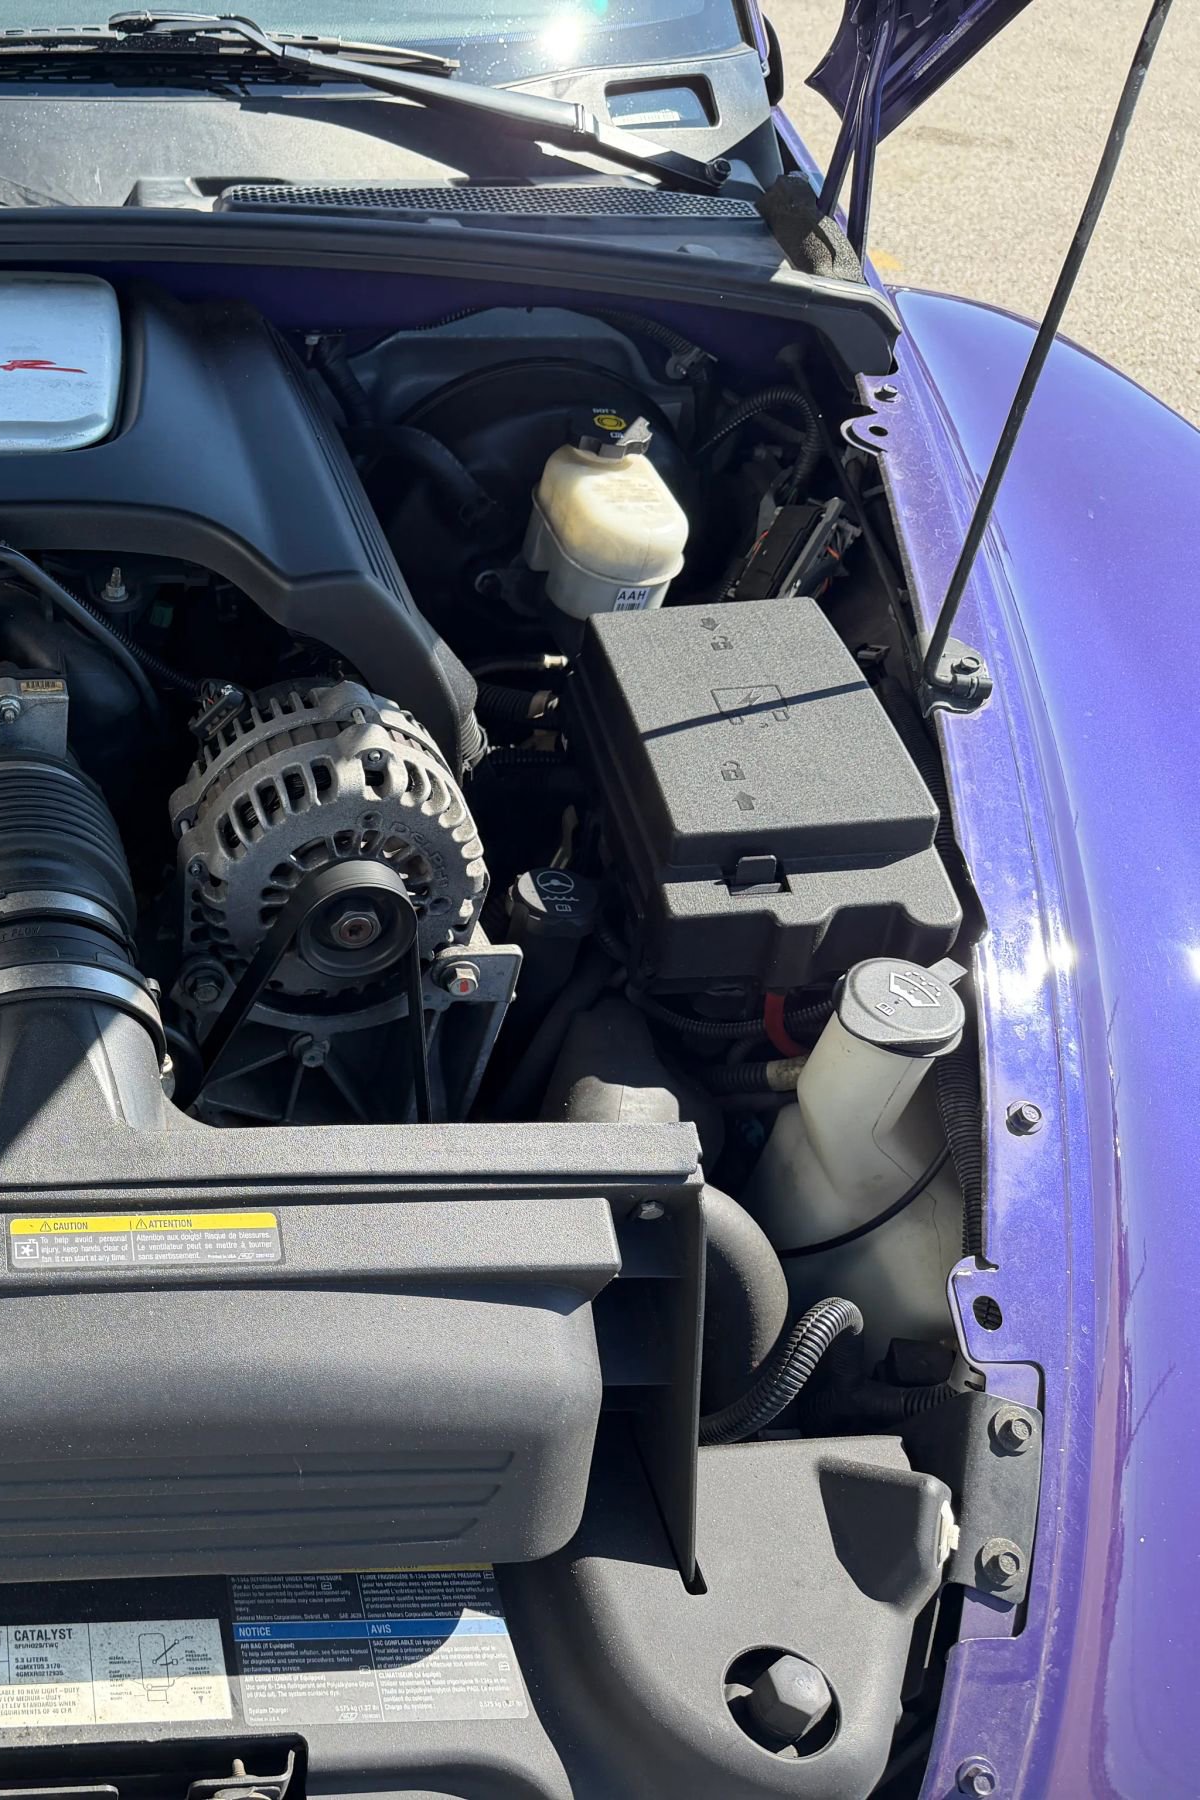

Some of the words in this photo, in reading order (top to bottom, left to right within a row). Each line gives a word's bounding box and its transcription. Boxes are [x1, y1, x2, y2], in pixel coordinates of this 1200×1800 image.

[617, 590, 648, 601] AAH
[53, 1222, 88, 1231] CAUTION
[148, 1219, 192, 1228] ATTENTION
[136, 1233, 165, 1241] Attention
[166, 1233, 178, 1241] aux
[204, 1232, 226, 1240] Risque
[228, 1232, 237, 1240] de
[238, 1231, 271, 1240] blessures.
[62, 1245, 78, 1253] keep
[80, 1244, 101, 1252] hands
[121, 1243, 128, 1251] of
[137, 1243, 146, 1251] Le
[148, 1243, 183, 1251] ventilateur
[186, 1242, 202, 1250] peut
[204, 1242, 213, 1250] se
[216, 1242, 238, 1250] mettre
[240, 1241, 246, 1249] à
[248, 1241, 272, 1249] tourner
[74, 1254, 89, 1262] start
[111, 1253, 128, 1261] time.
[138, 1253, 154, 1261] sans
[154, 1252, 200, 1260] avertissement.
[239, 1626, 271, 1636] NOTICE
[371, 1624, 392, 1633] AVIS
[14, 1628, 72, 1641] CATALYST
